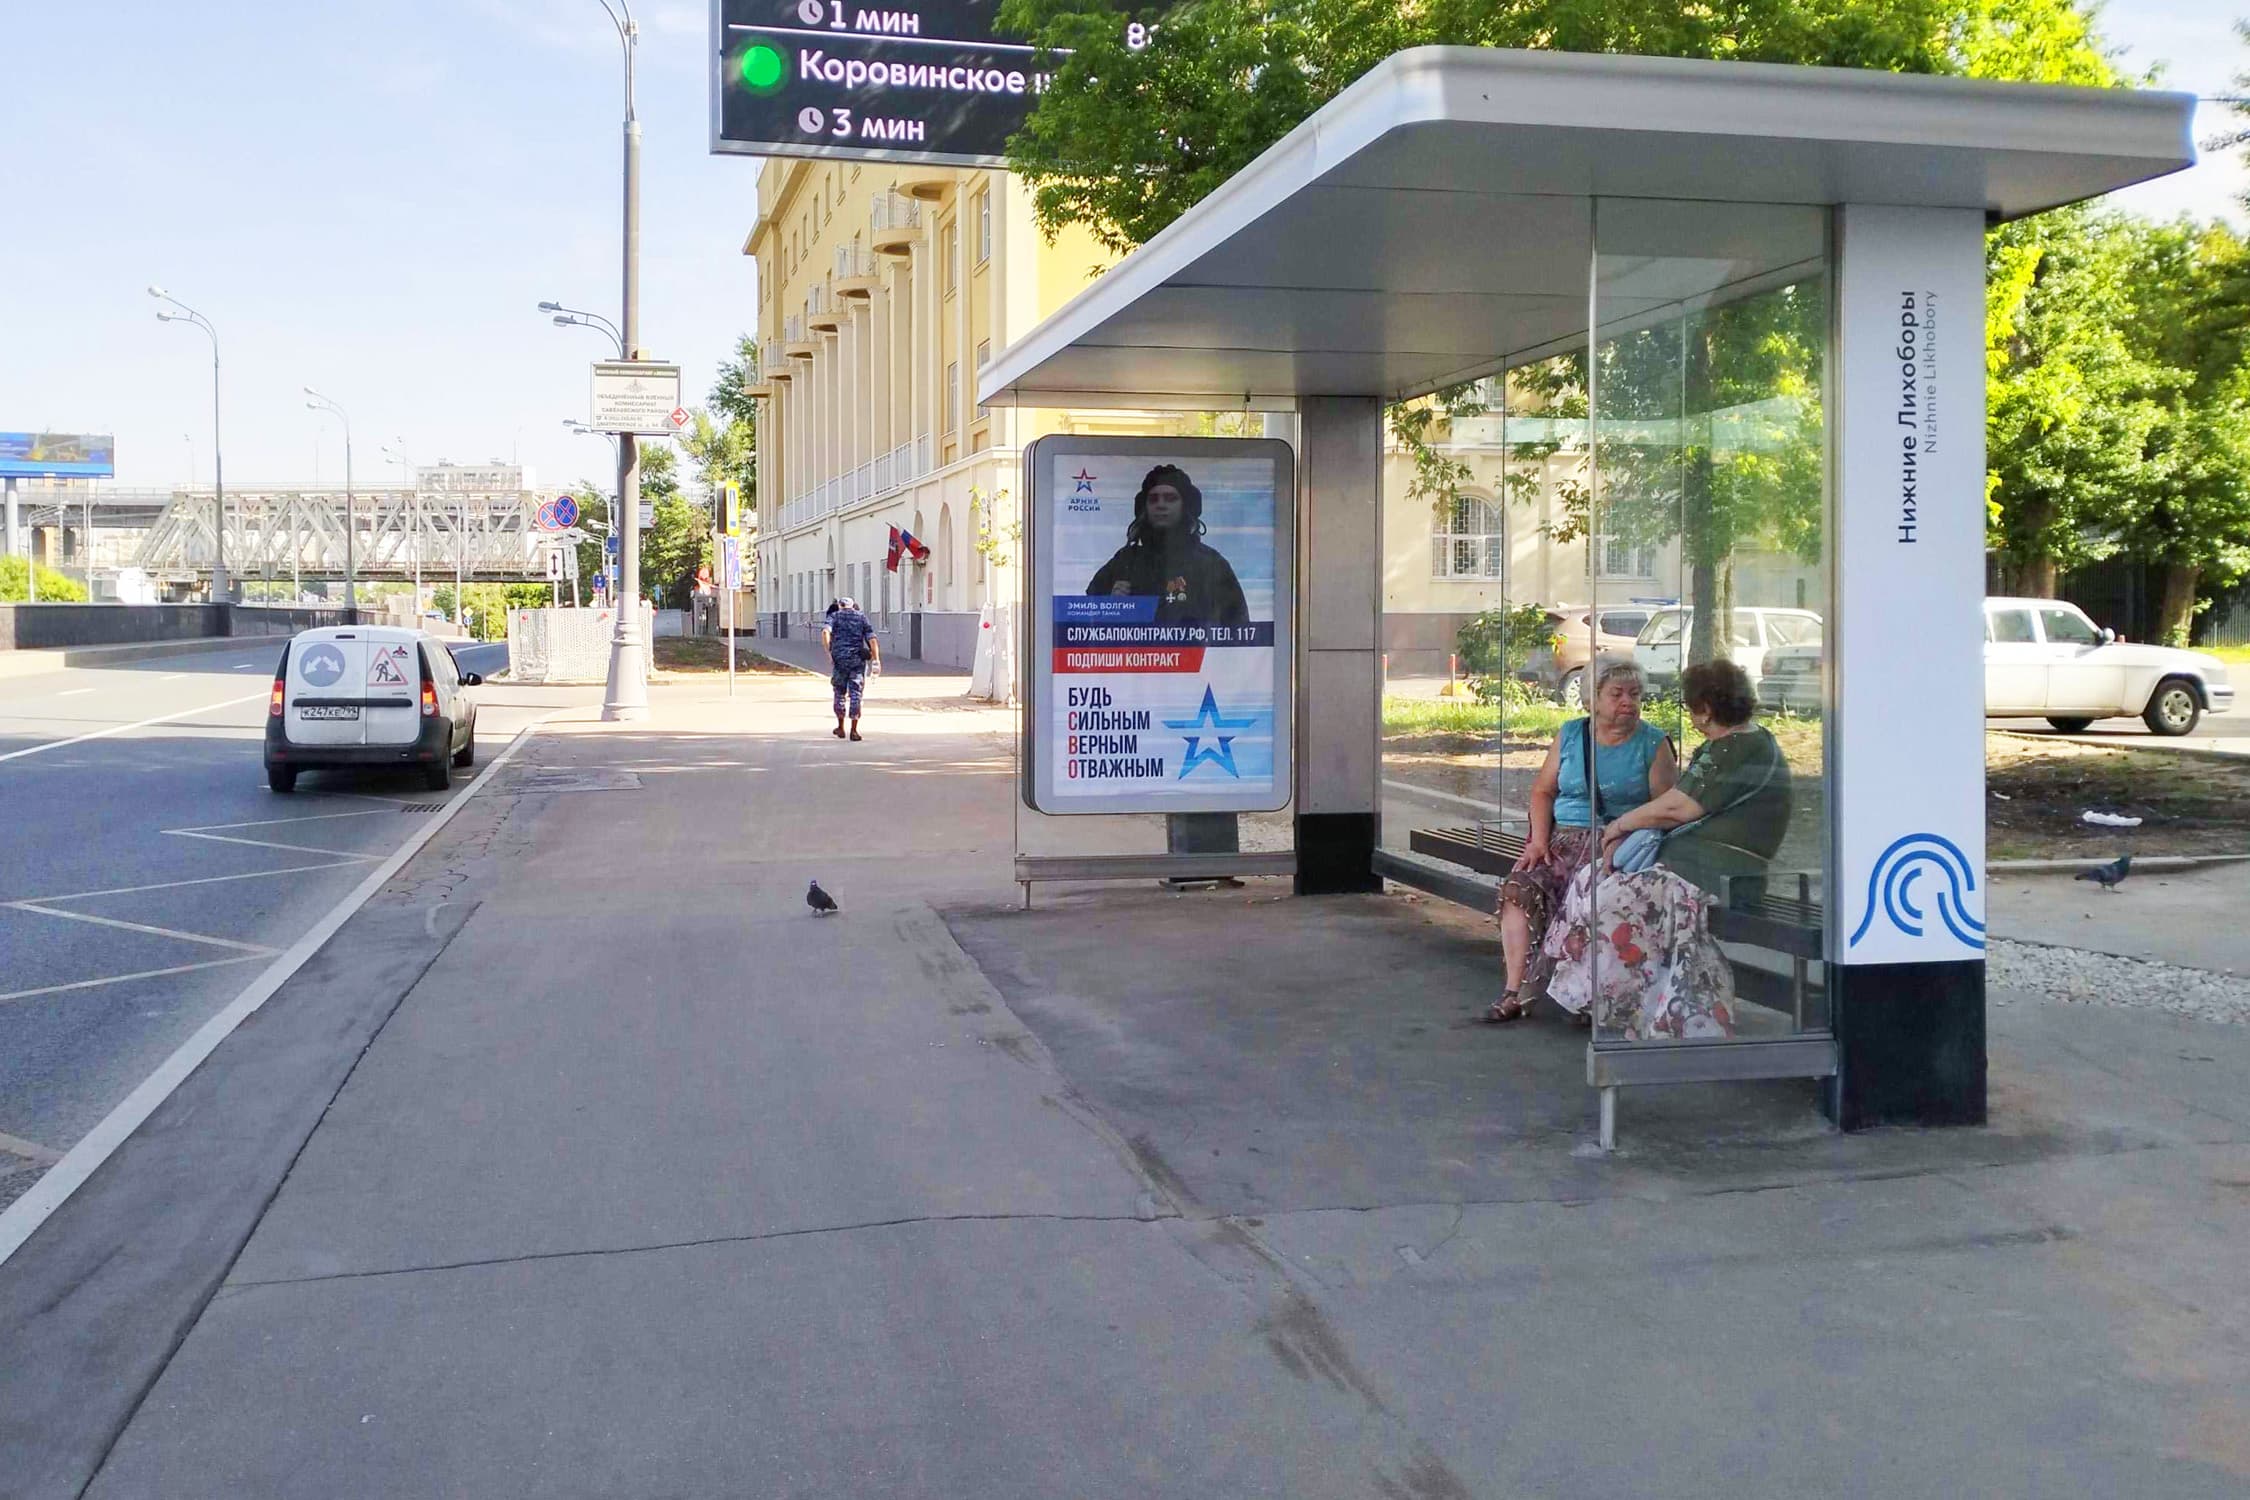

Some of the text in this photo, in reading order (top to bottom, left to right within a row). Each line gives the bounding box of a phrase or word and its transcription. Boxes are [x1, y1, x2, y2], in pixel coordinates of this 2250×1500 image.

[829, 0, 919, 34] 1 мин
[800, 49, 1025, 93] Коровинское
[832, 108, 925, 141] 3 мин
[1923, 290, 1938, 453] Nizhnie Likhobory
[1897, 291, 1919, 543] Нижние Лихоборы
[1068, 602, 1135, 610] ЭМИЛЬ ВОЛГИН
[1067, 626, 1256, 643] СЛУЖБАПОКОНТРАКТУ.РФ, ТЕЛ. 117
[1067, 652, 1181, 668] ПОДПИШИ КОНТРАКТ
[1068, 687, 1112, 709] БУДЬ
[1068, 711, 1151, 731] СИЛЬНЫМ
[1068, 735, 1138, 755] ВЕРНЫМ
[1068, 758, 1164, 779] ОТВАЖНЫМ
